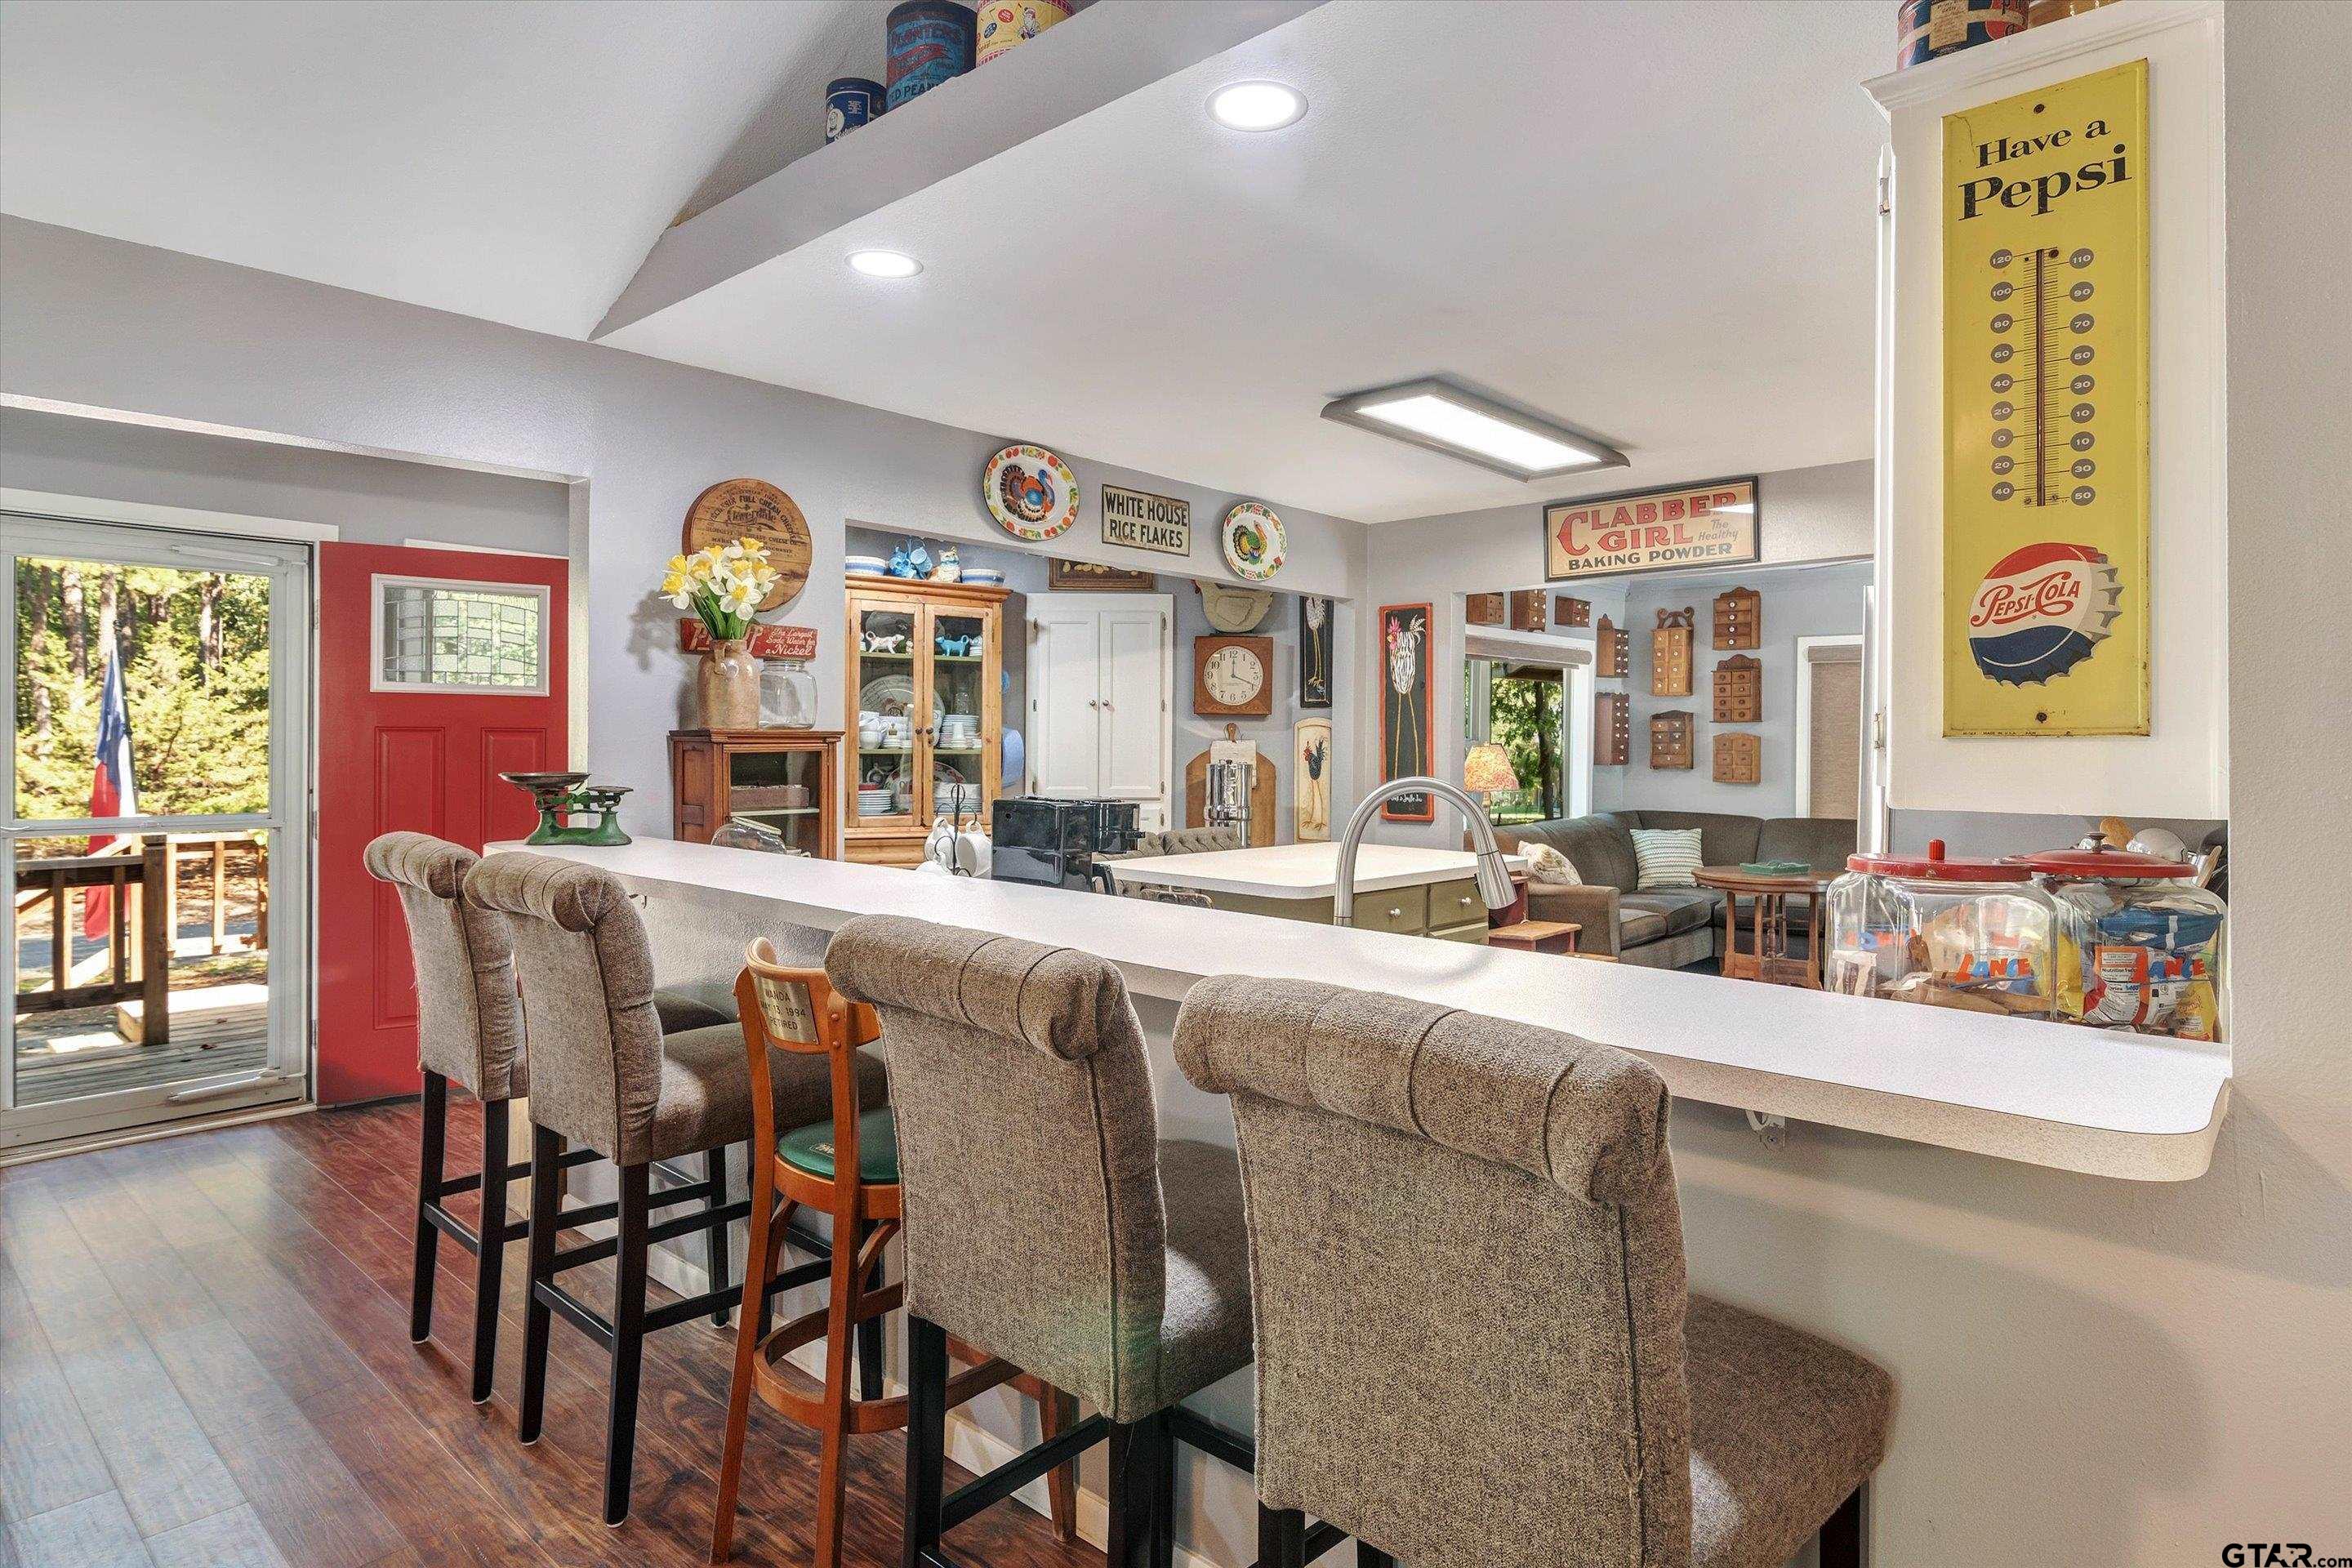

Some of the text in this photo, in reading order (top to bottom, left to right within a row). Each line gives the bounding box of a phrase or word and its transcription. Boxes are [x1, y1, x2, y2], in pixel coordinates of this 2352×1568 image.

[1976, 119, 2111, 169] Have a
[1958, 144, 2132, 220] Pepsi
[1993, 255, 2011, 265] 120
[2073, 255, 2091, 263] 110
[1993, 287, 2011, 296] 100
[2074, 288, 2091, 296] 90
[1994, 319, 2009, 327] 80
[2074, 351, 2091, 359] 50
[2074, 381, 2091, 389] 30
[2075, 409, 2090, 417] 10
[2076, 438, 2090, 446] 10
[2074, 465, 2091, 473] 30
[2074, 492, 2091, 500] 50
[759, 497, 782, 516] CREAM
[1105, 491, 1187, 527] WHITE HOUSE
[1710, 519, 1729, 530] The
[1110, 519, 1183, 548] RICE FLAKES
[1597, 523, 1693, 551] GIRL
[1698, 528, 1739, 541] Healthy
[1568, 542, 1732, 570] BAKING POWDER
[771, 644, 813, 656] Nickel
[1230, 650, 1238, 658] 12
[1219, 653, 1226, 662] 11
[1211, 661, 1220, 669] 10
[1207, 671, 1213, 679] 9
[1210, 682, 1217, 691] 8
[1220, 690, 1226, 698] 7
[1230, 693, 1236, 701] 6
[1953, 953, 2030, 982] LANCE
[786, 1007, 806, 1018] 1994
[769, 1016, 798, 1031] RETIRED
